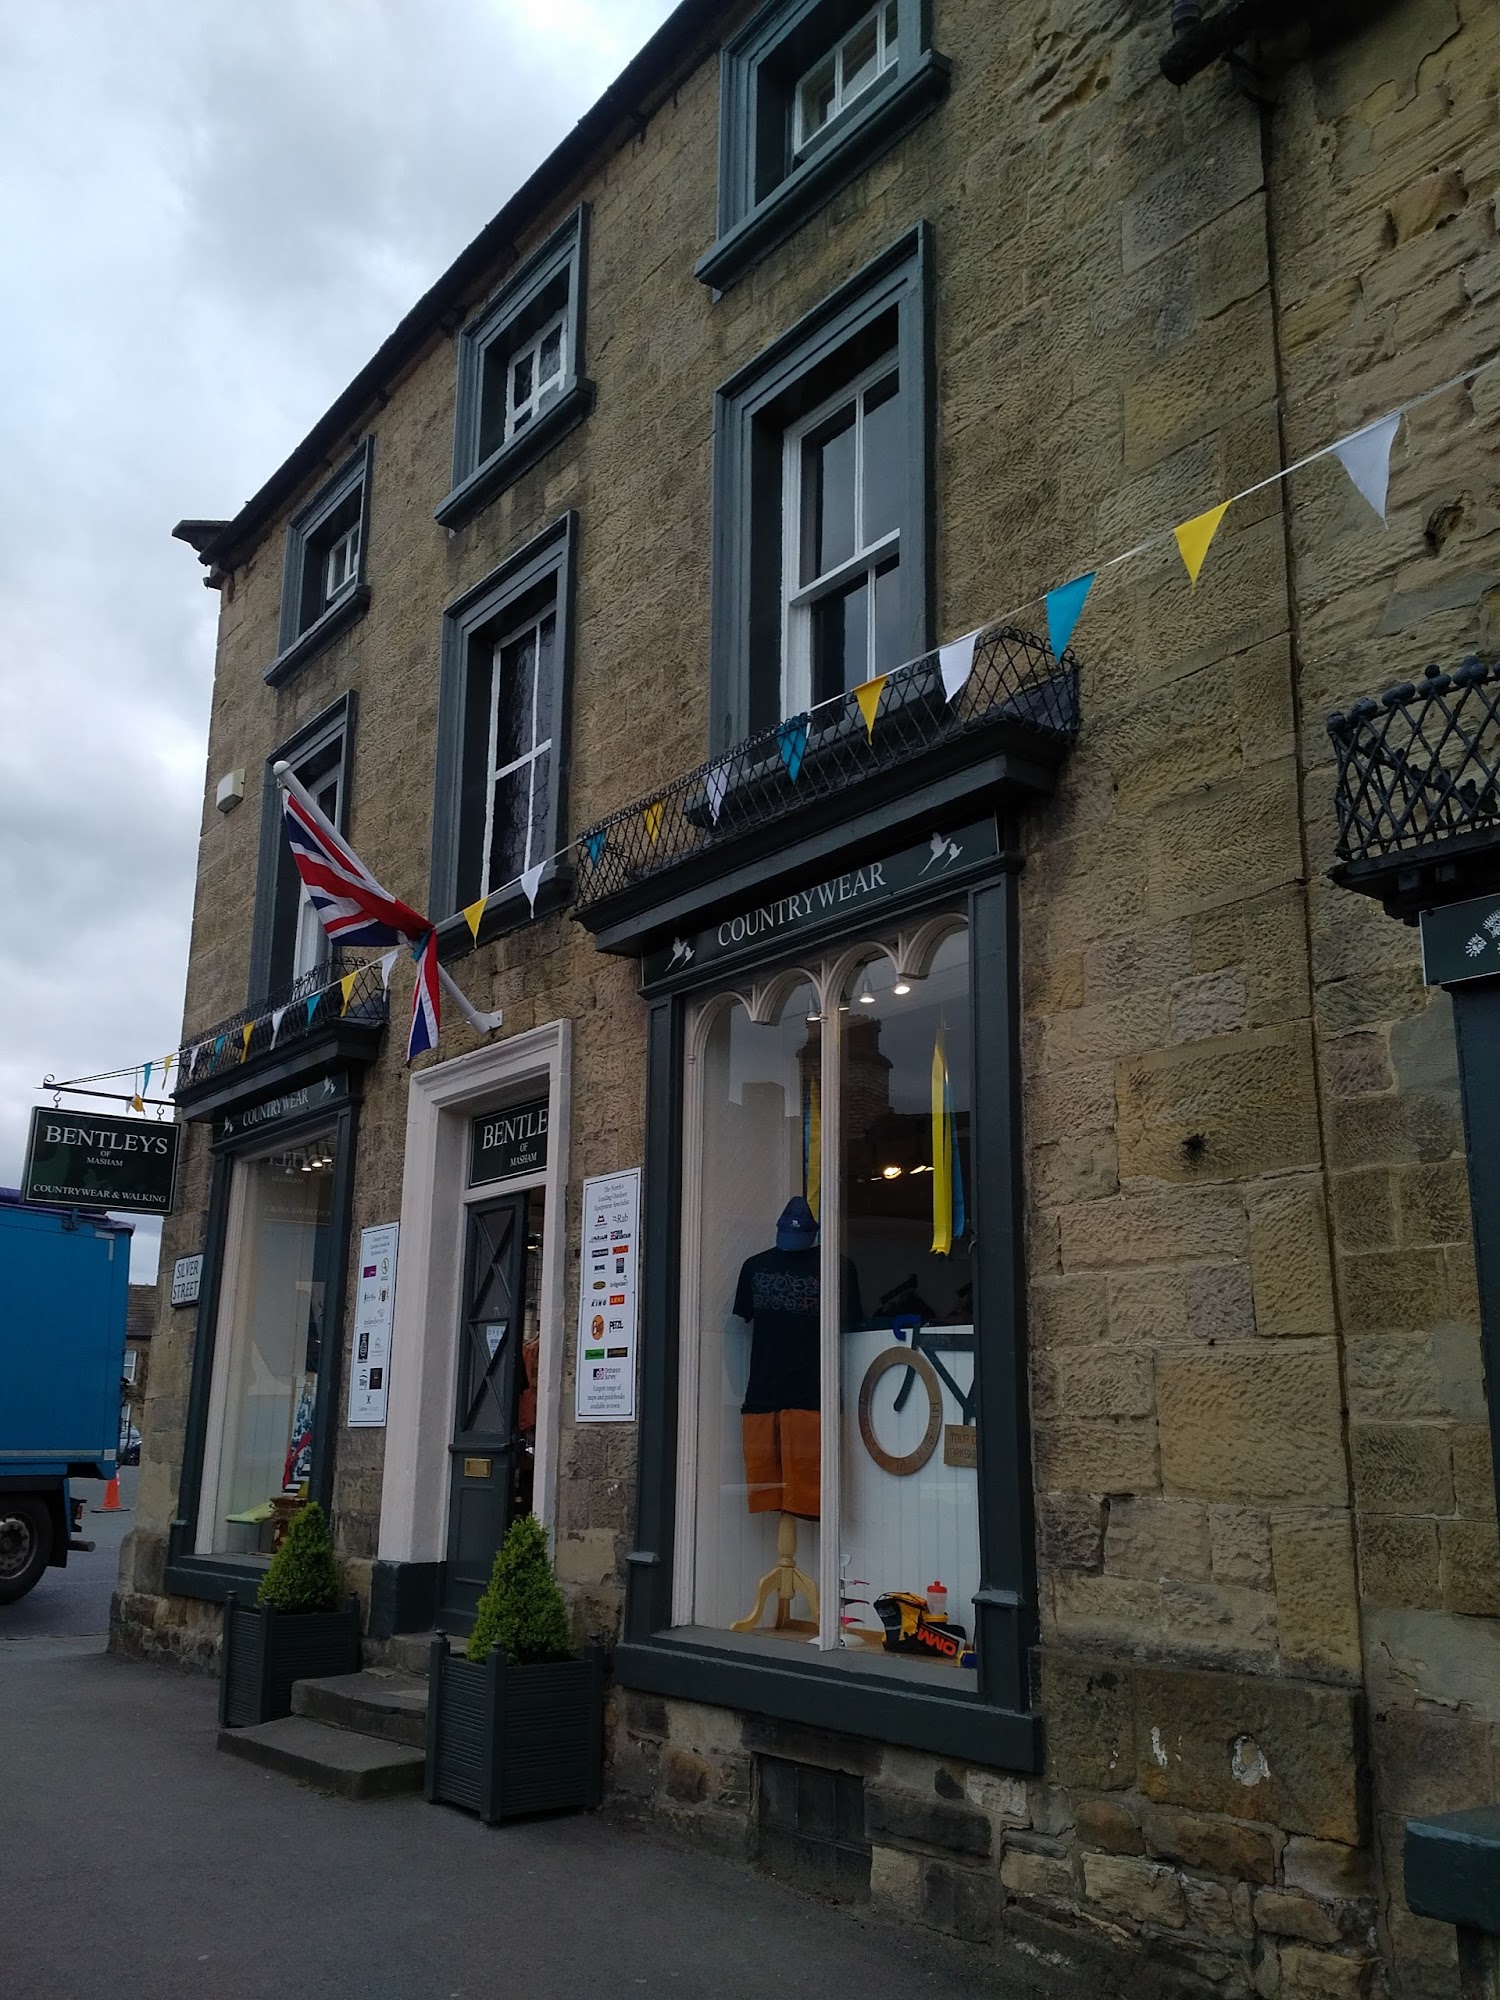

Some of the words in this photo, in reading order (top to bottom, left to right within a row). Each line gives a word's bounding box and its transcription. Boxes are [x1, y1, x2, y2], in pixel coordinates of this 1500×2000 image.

[717, 862, 886, 947] COUNTRYWEAR
[243, 1088, 308, 1126] COUNTRYWEAR
[482, 1108, 548, 1150] BENTLE
[44, 1125, 168, 1155] BENTLEYS
[520, 1142, 528, 1153] OF
[86, 1156, 123, 1167] MASHAM
[510, 1152, 538, 1167] MASHAM
[33, 1183, 110, 1199] COUNTRYWEAR
[112, 1191, 120, 1199] &
[121, 1192, 166, 1203] WALKING
[176, 1260, 198, 1278] SILVER
[172, 1280, 198, 1300] STREET
[605, 1392, 625, 1402] guidebooks
